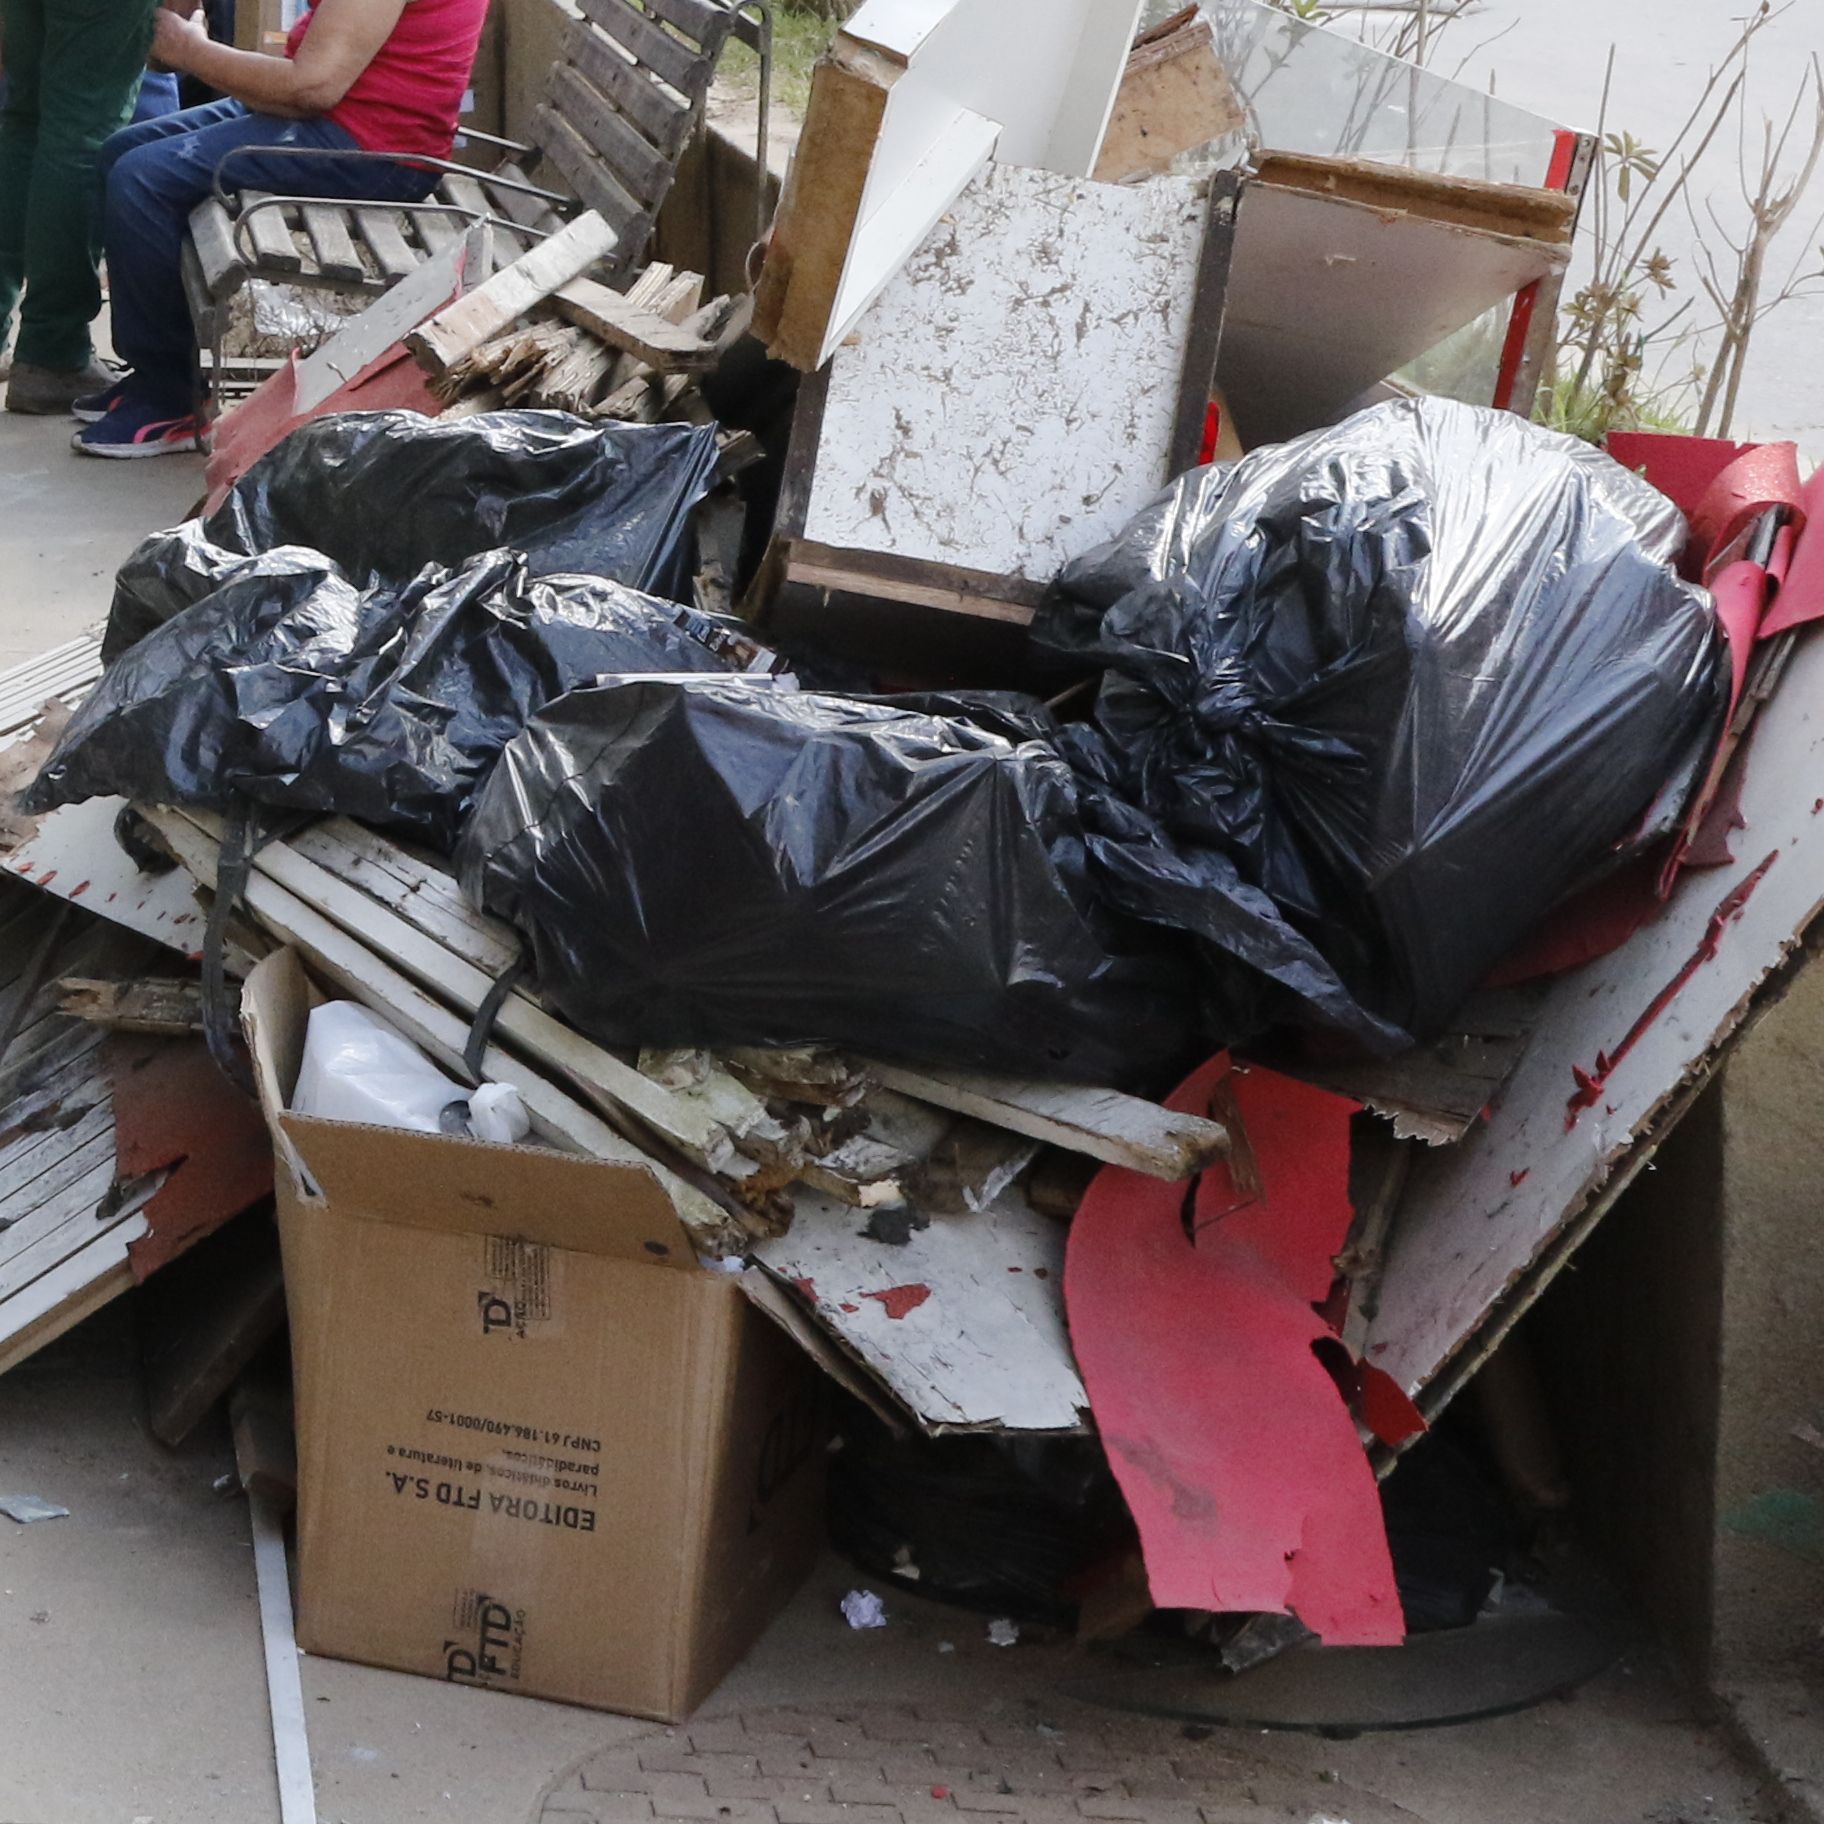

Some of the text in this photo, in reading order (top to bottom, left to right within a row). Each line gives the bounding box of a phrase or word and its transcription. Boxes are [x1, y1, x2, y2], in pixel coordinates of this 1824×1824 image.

[425, 1407, 602, 1453] CNPJ 61.186.490/0001-57
[386, 1445, 396, 1457] e
[397, 1447, 463, 1472] literatura
[465, 1461, 483, 1476] de
[553, 1477, 598, 1498] Livros
[384, 1470, 596, 1533] EDITORA FTD S.A.
[475, 1594, 511, 1676] FTD
